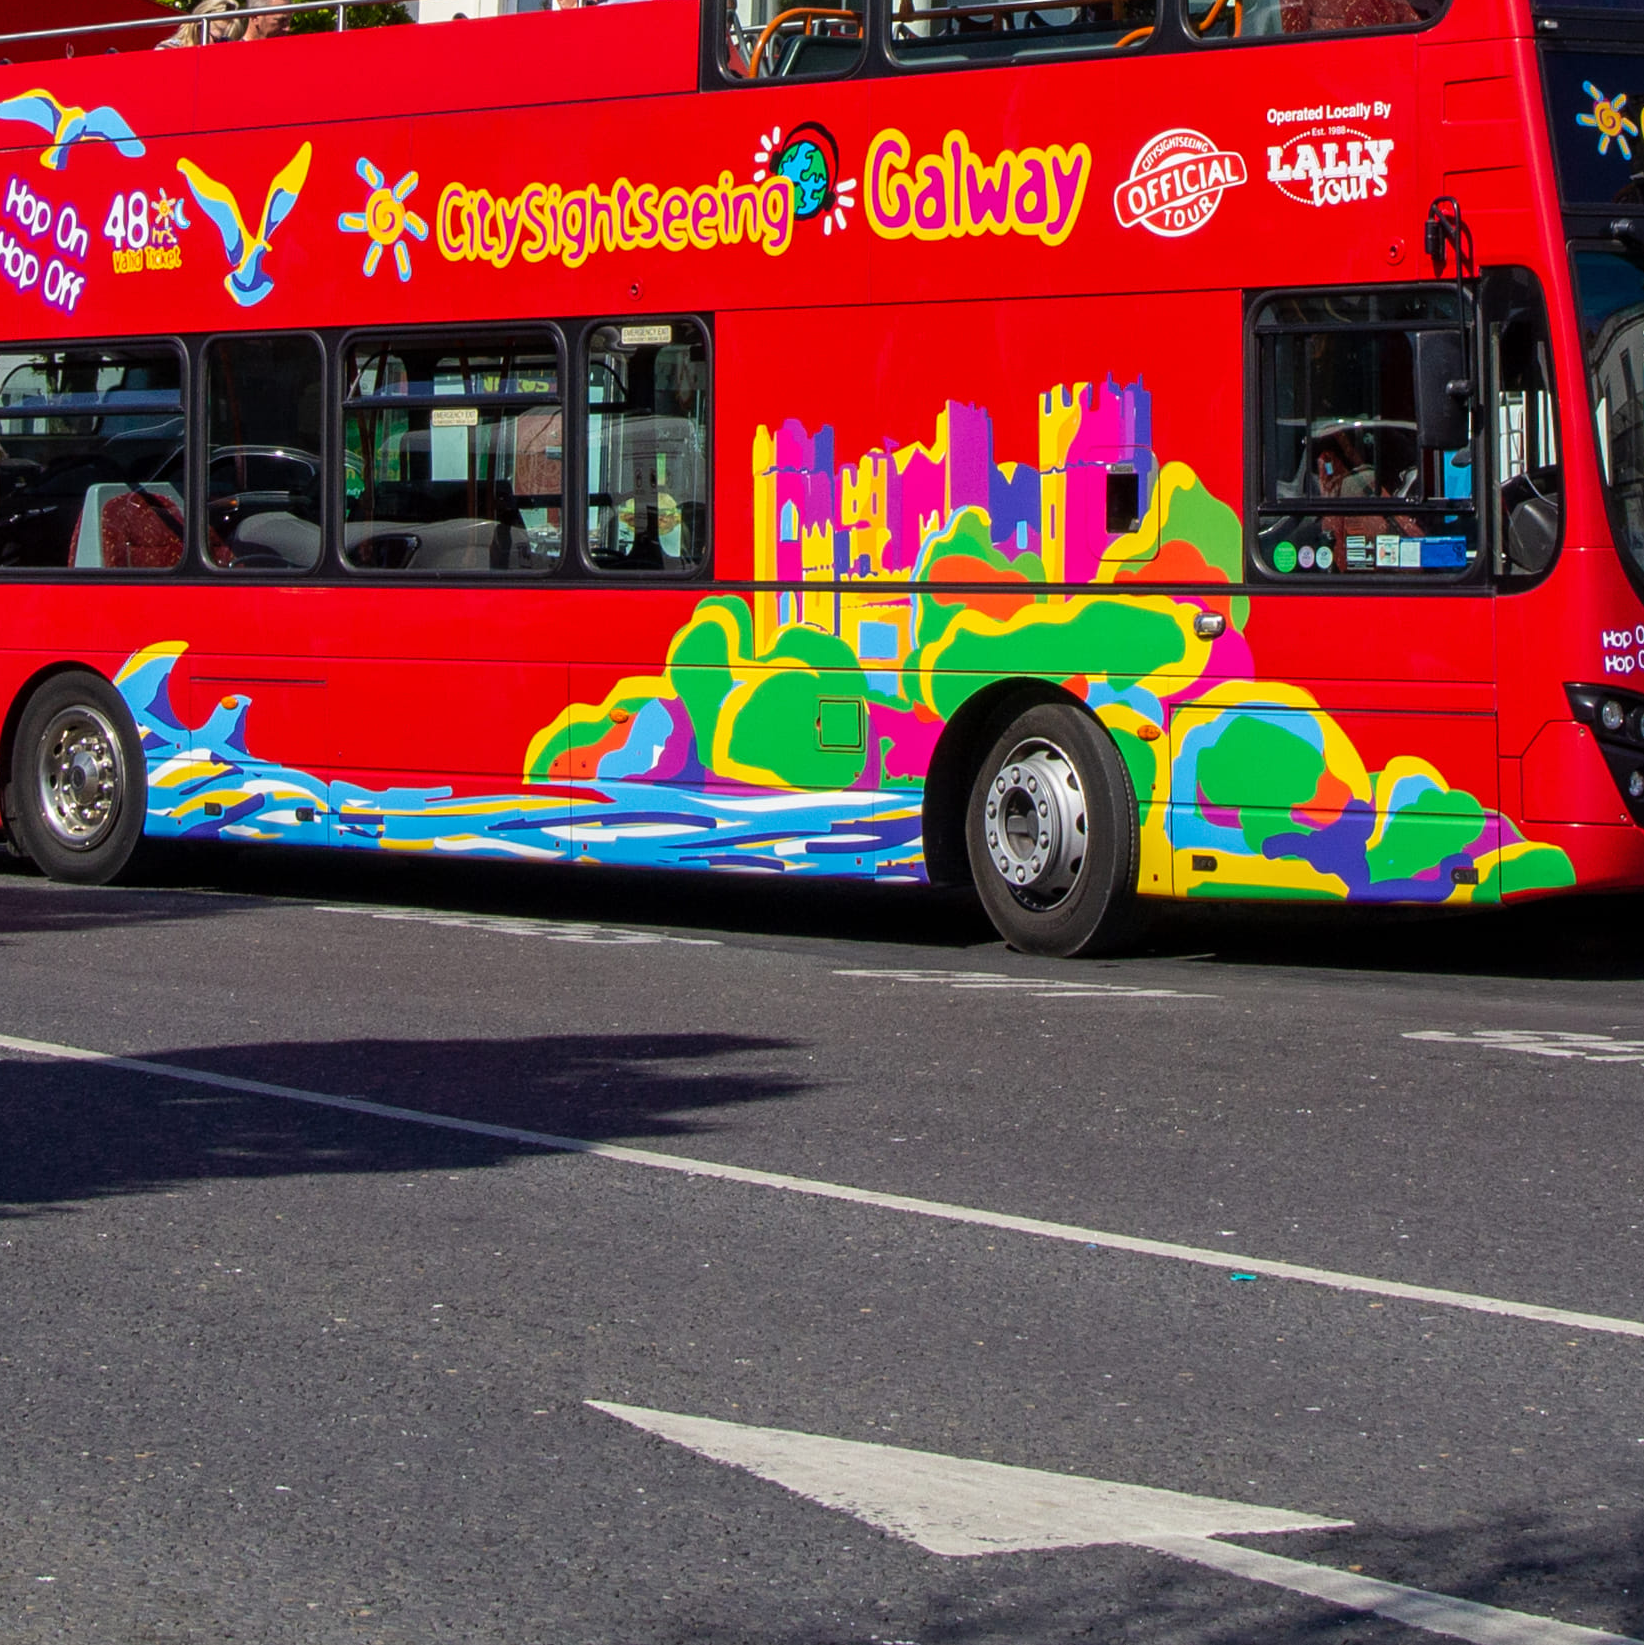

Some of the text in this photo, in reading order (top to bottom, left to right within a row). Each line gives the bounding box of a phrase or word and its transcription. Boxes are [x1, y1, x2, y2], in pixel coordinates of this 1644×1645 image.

[1267, 101, 1392, 126] Operated Locally By
[1141, 136, 1210, 172] CITYSIGHTSEEING
[1267, 139, 1394, 181] LALLY
[437, 128, 1092, 268] CitySightseeing Galway
[1128, 158, 1239, 215] OFFICIAL
[1310, 173, 1388, 207] tours
[6, 178, 88, 257] Hop On
[104, 192, 150, 248] 48
[1163, 197, 1213, 228] TOUR
[112, 246, 182, 274] Valid Ticket
[44, 260, 85, 311] Off
[1602, 630, 1632, 649] Hop
[1605, 654, 1635, 673] Hop
